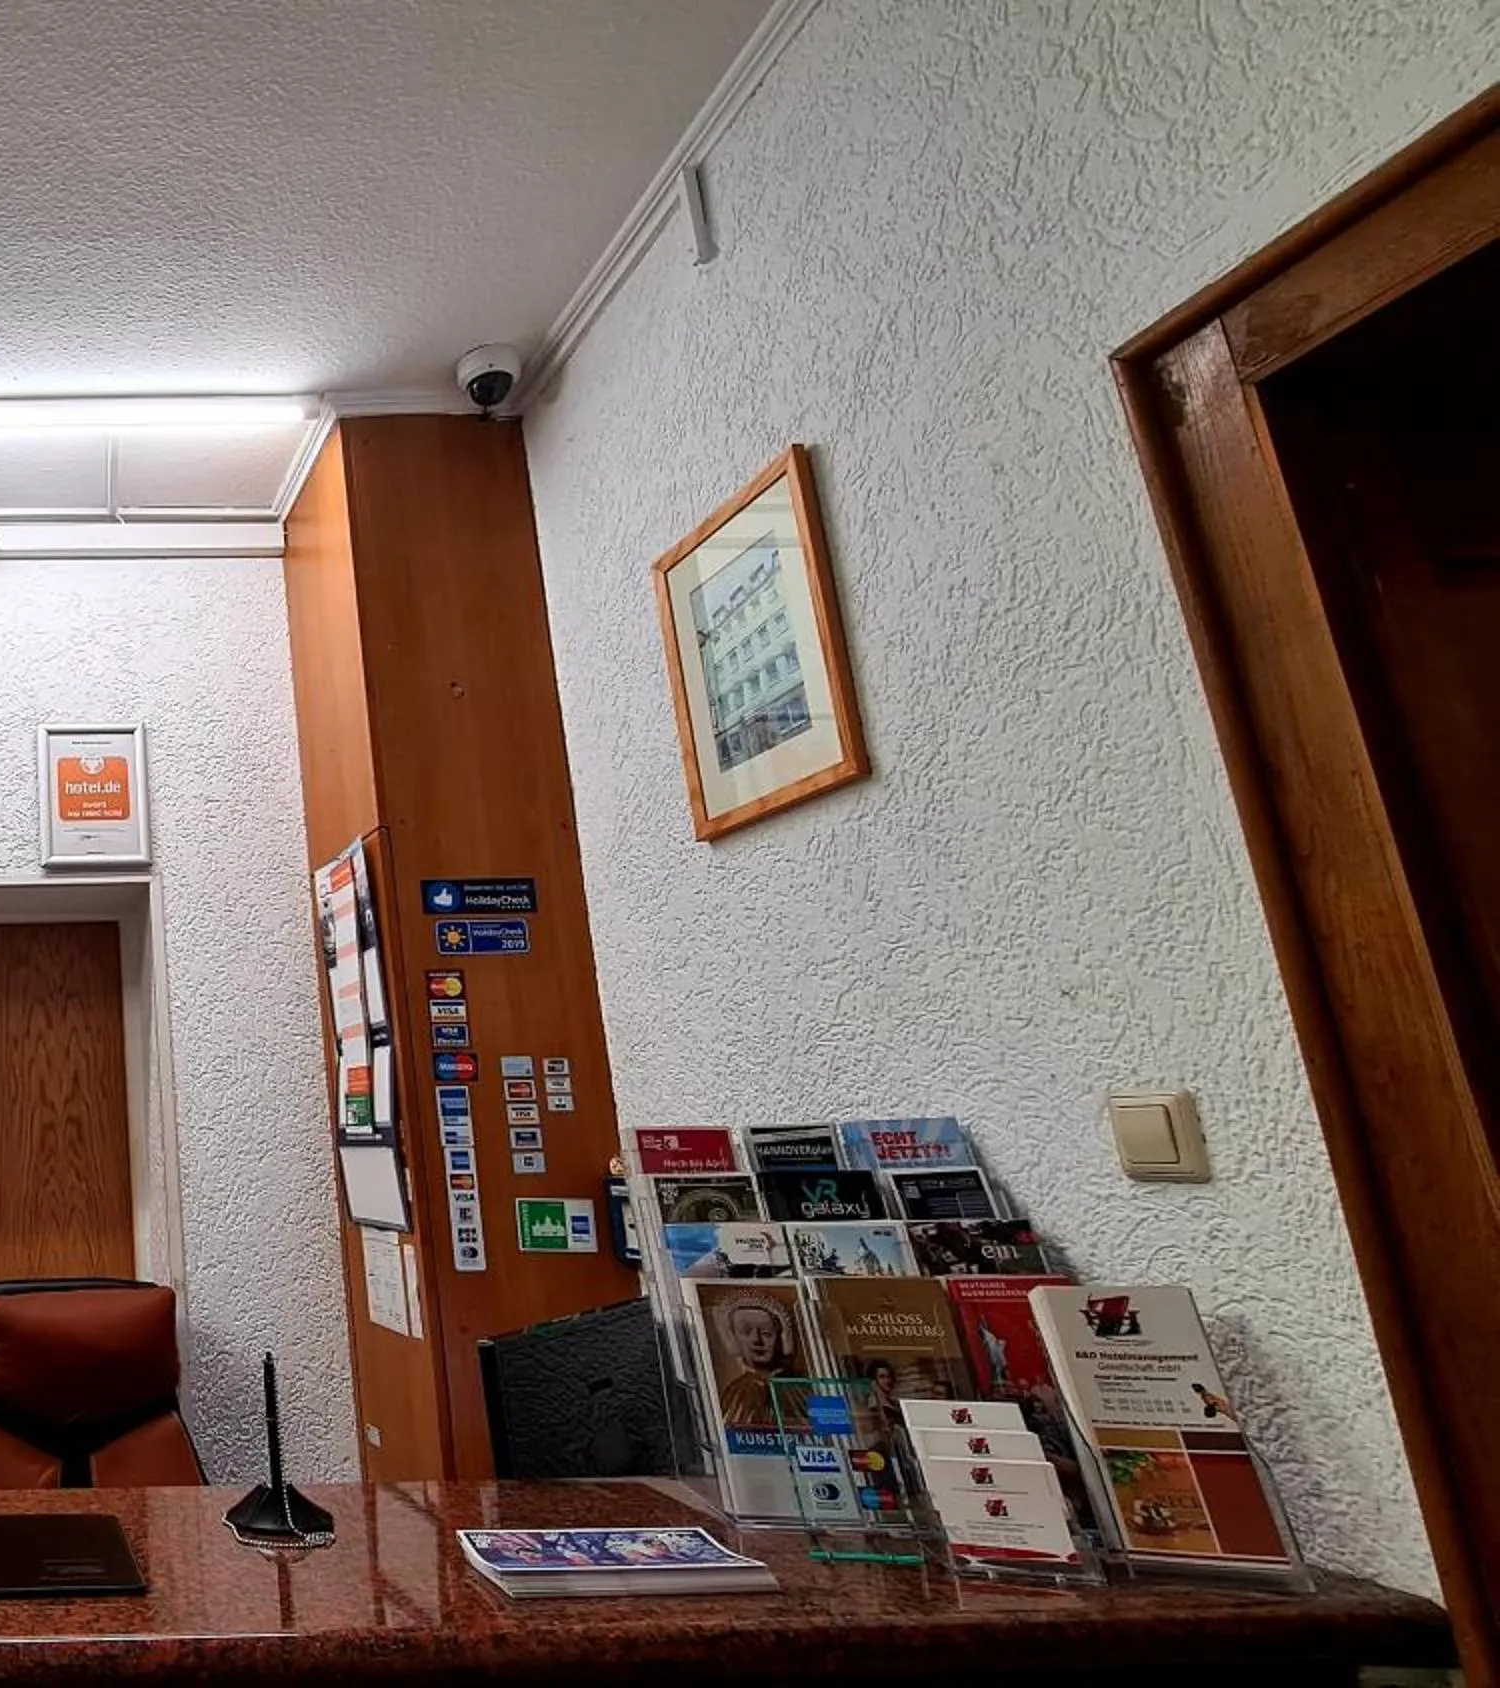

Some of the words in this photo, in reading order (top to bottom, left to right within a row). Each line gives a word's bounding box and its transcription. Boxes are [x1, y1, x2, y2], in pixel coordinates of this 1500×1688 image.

[64, 781, 121, 795] hotel.de
[465, 895, 531, 906] HolidayCheck
[501, 939, 525, 949] 2019
[870, 1130, 917, 1146] ECHT
[801, 1178, 840, 1202] VR
[801, 1200, 871, 1219] galaxy
[860, 1312, 924, 1325] SCHLOSS
[847, 1324, 945, 1338] MARIENBURG
[802, 1450, 838, 1464] VISA
